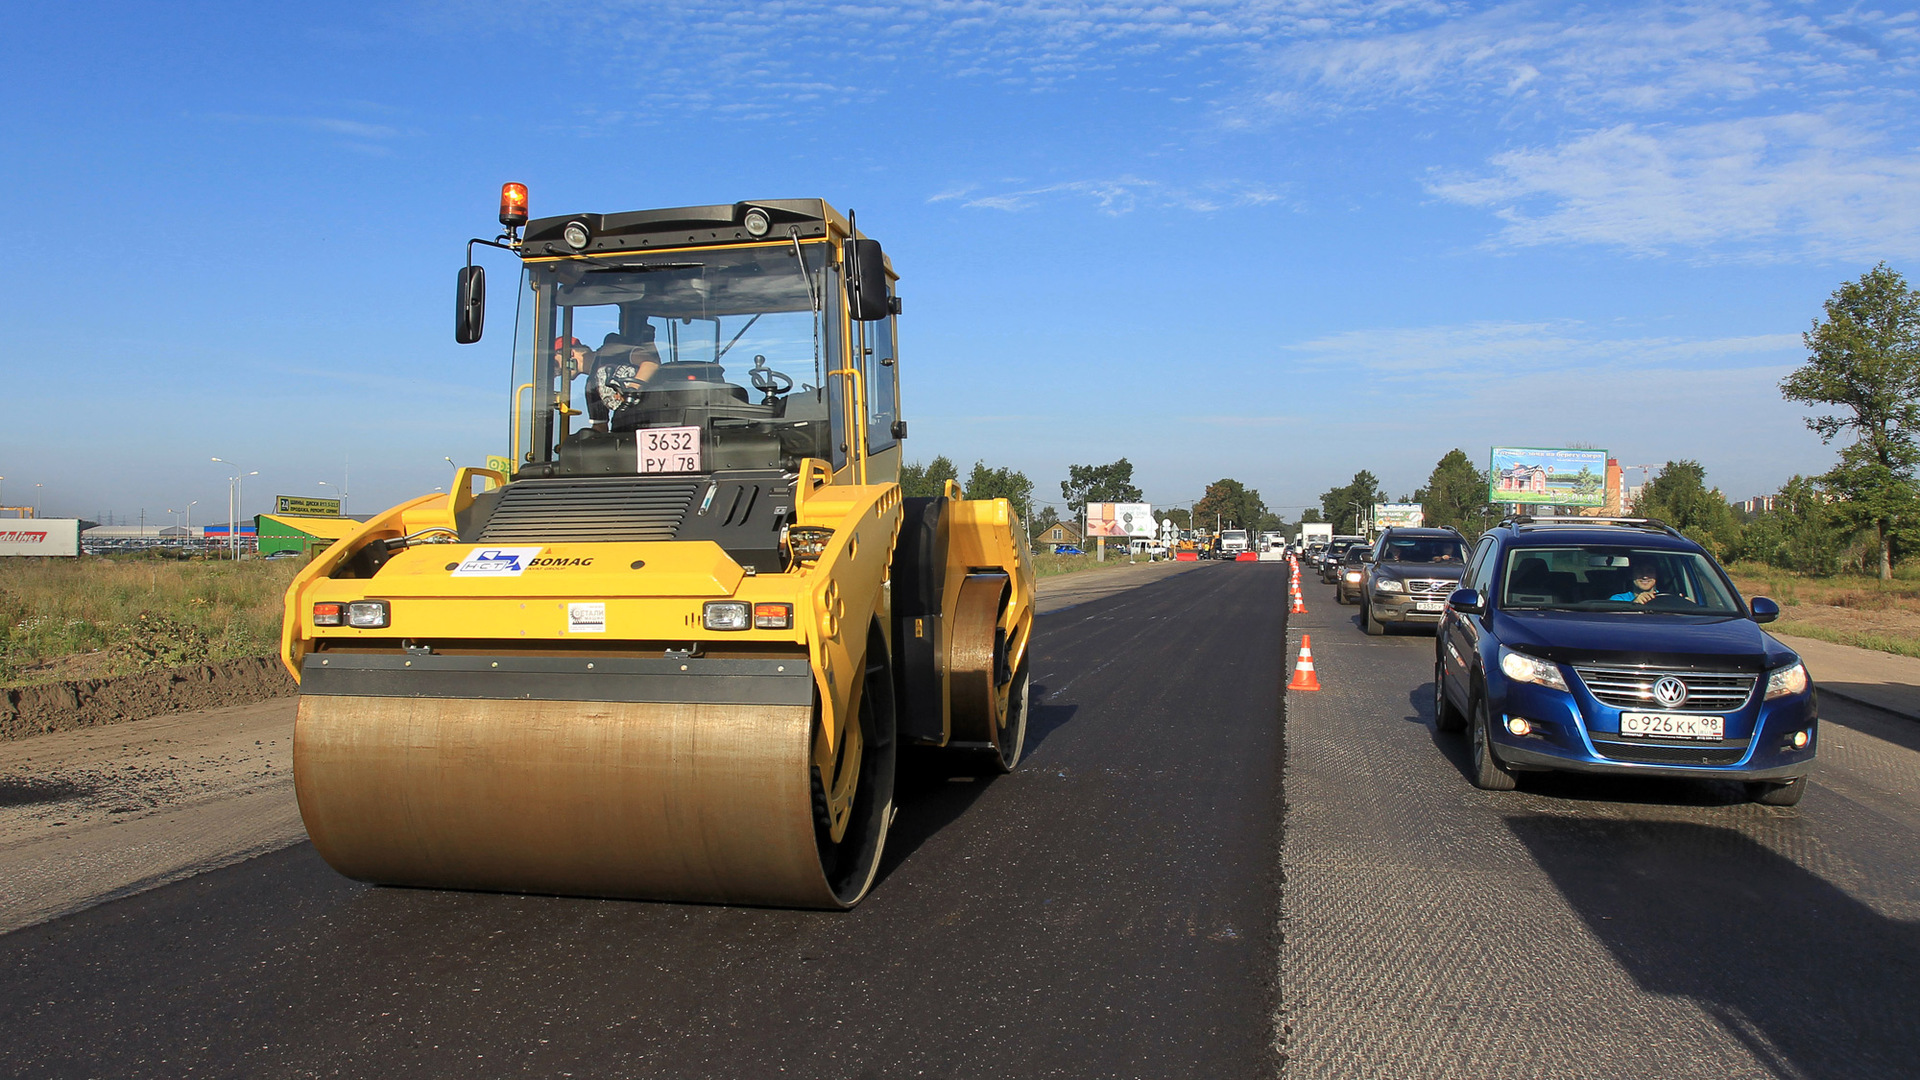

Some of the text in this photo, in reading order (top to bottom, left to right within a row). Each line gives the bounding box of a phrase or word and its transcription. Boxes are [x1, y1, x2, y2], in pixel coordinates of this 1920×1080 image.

[648, 432, 692, 451] 3632
[678, 457, 695, 471] 78
[281, 500, 289, 510] 24
[528, 557, 594, 567] BOMAG
[1701, 718, 1718, 730] 98
